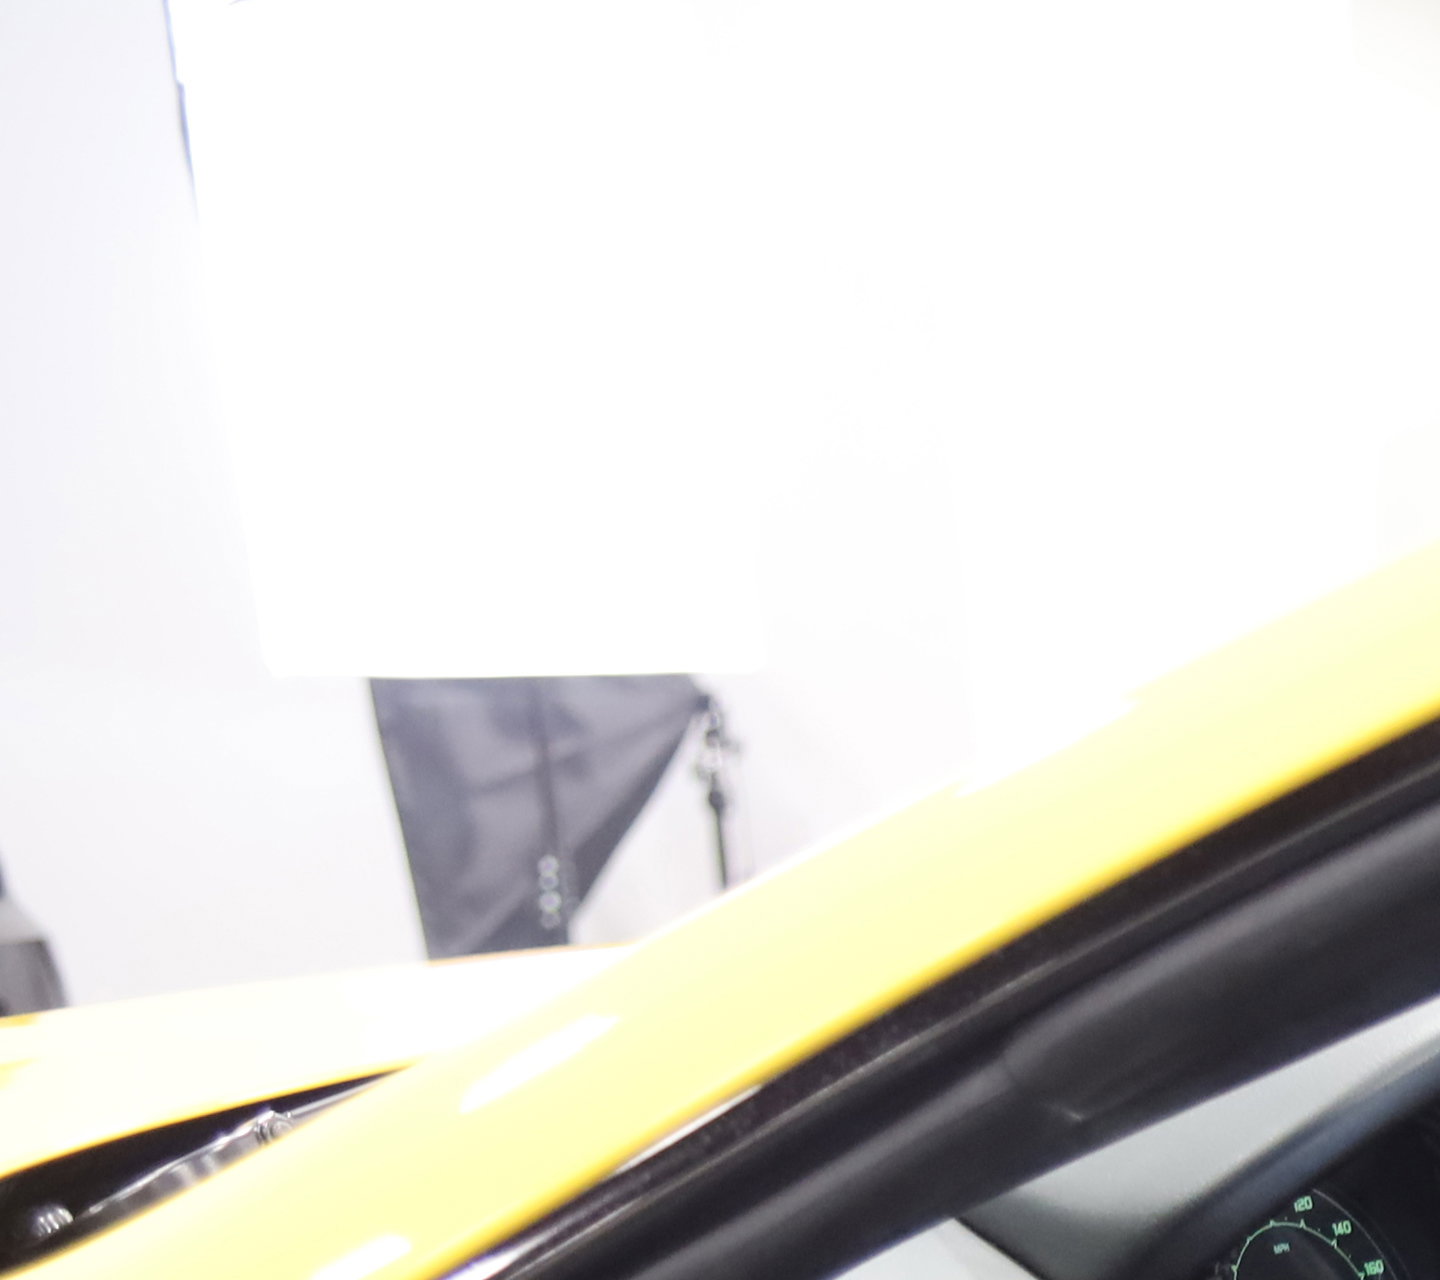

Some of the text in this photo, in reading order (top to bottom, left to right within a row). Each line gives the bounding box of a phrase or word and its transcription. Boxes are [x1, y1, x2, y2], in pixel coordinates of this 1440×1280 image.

[1293, 1196, 1313, 1213] 120
[1332, 1220, 1352, 1236] 140
[1273, 1242, 1290, 1255] MPH
[1364, 1259, 1385, 1276] 160
